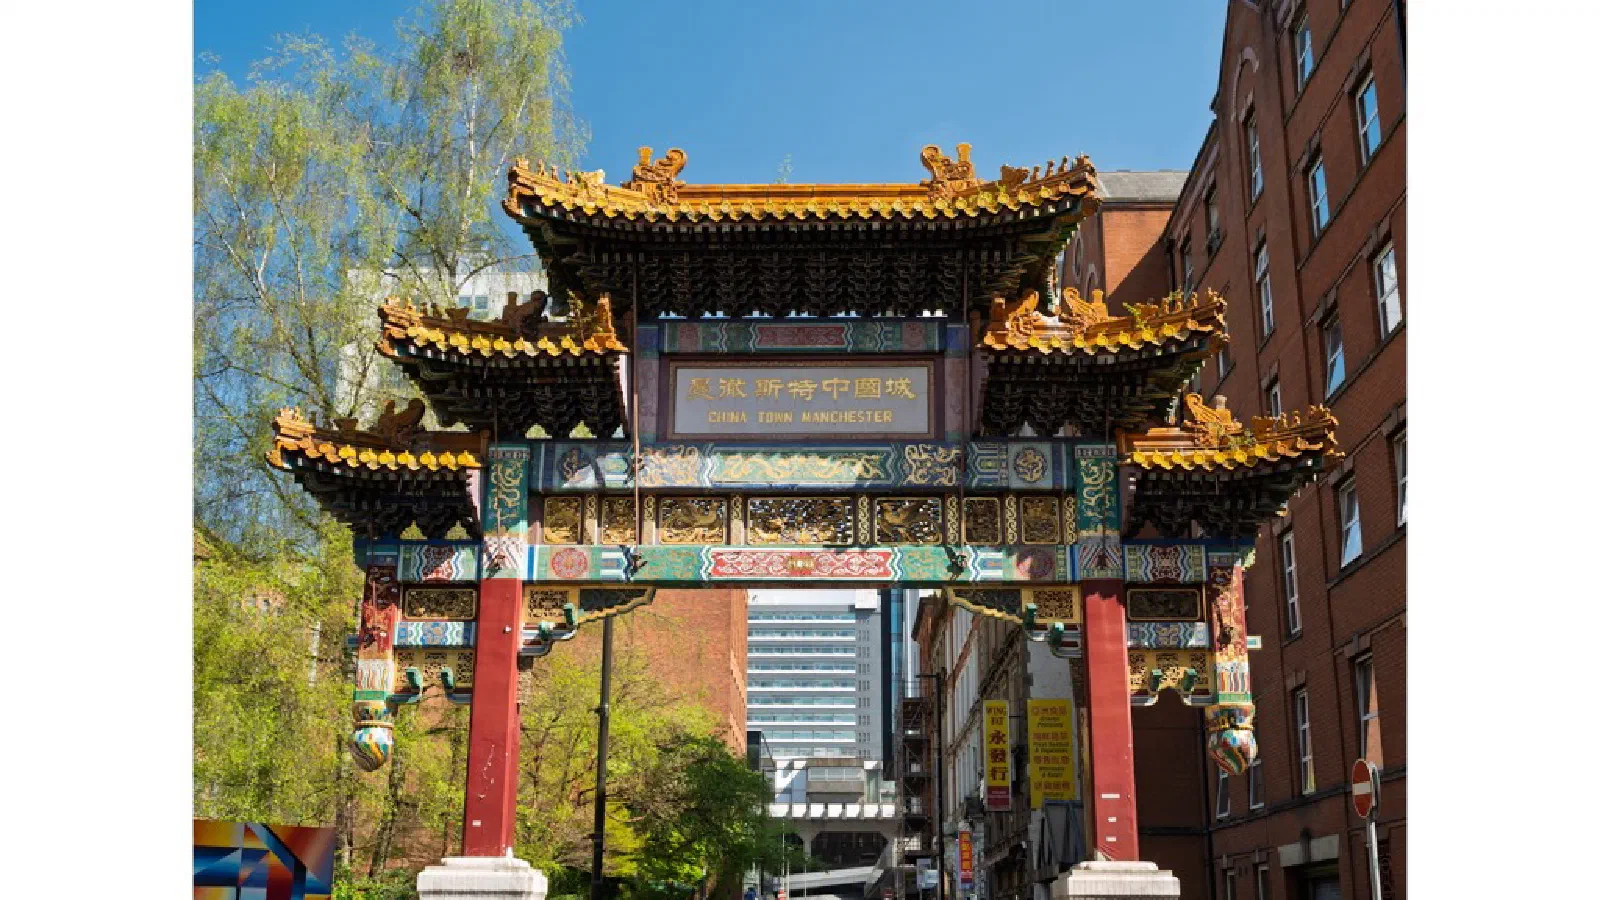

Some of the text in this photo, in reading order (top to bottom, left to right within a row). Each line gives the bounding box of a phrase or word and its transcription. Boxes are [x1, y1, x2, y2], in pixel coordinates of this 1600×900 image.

[708, 411, 892, 423] CHINA TOWN MANCHESTER
[986, 705, 1007, 716] WING
